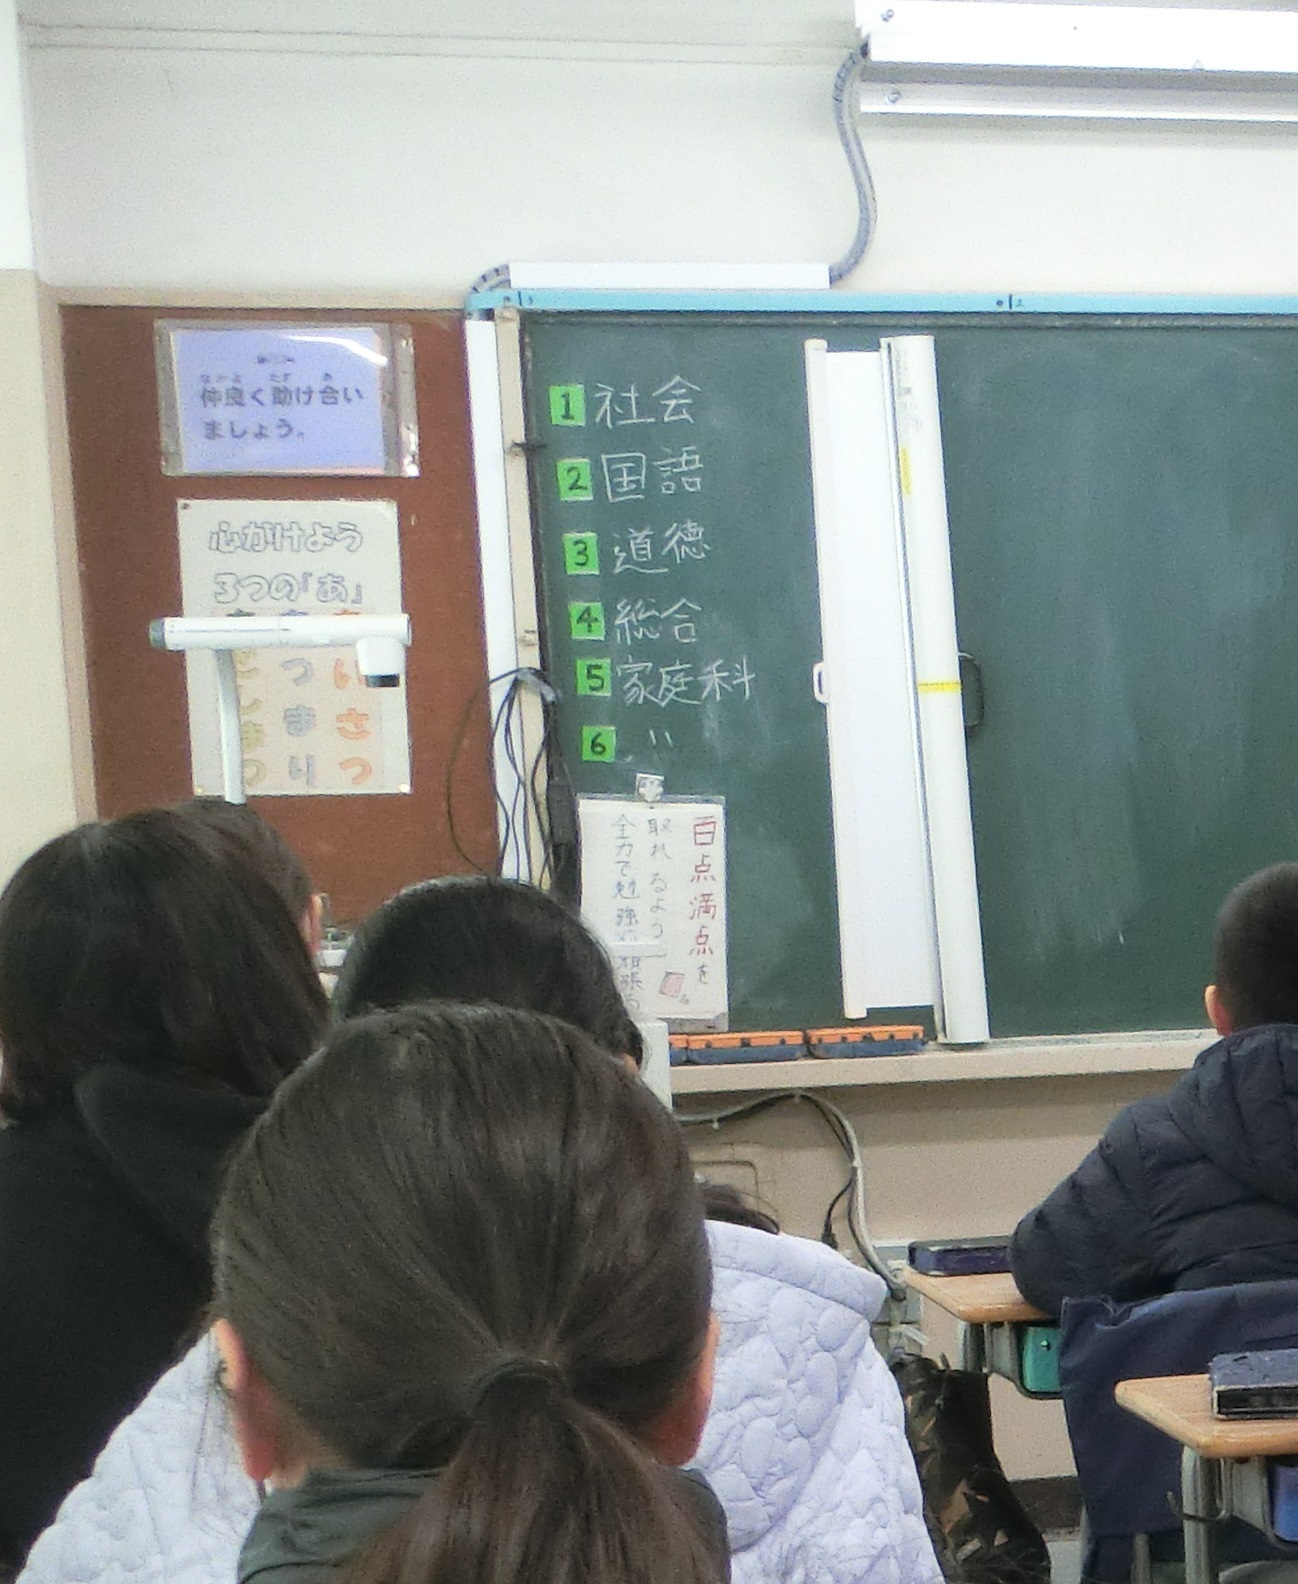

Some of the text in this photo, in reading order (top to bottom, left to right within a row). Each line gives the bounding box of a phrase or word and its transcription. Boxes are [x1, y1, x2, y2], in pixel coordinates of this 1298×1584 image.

[200, 386, 366, 408] 仲良く助け合い
[561, 375, 703, 430] 1 社会
[566, 445, 704, 504] 2 国語
[209, 520, 364, 554] 心がけよう
[572, 518, 712, 574] 3 道徳
[576, 597, 703, 646] 4 総合
[585, 654, 757, 708] 5 家庭科
[589, 732, 607, 756] 6
[688, 815, 717, 986] 百点満点を
